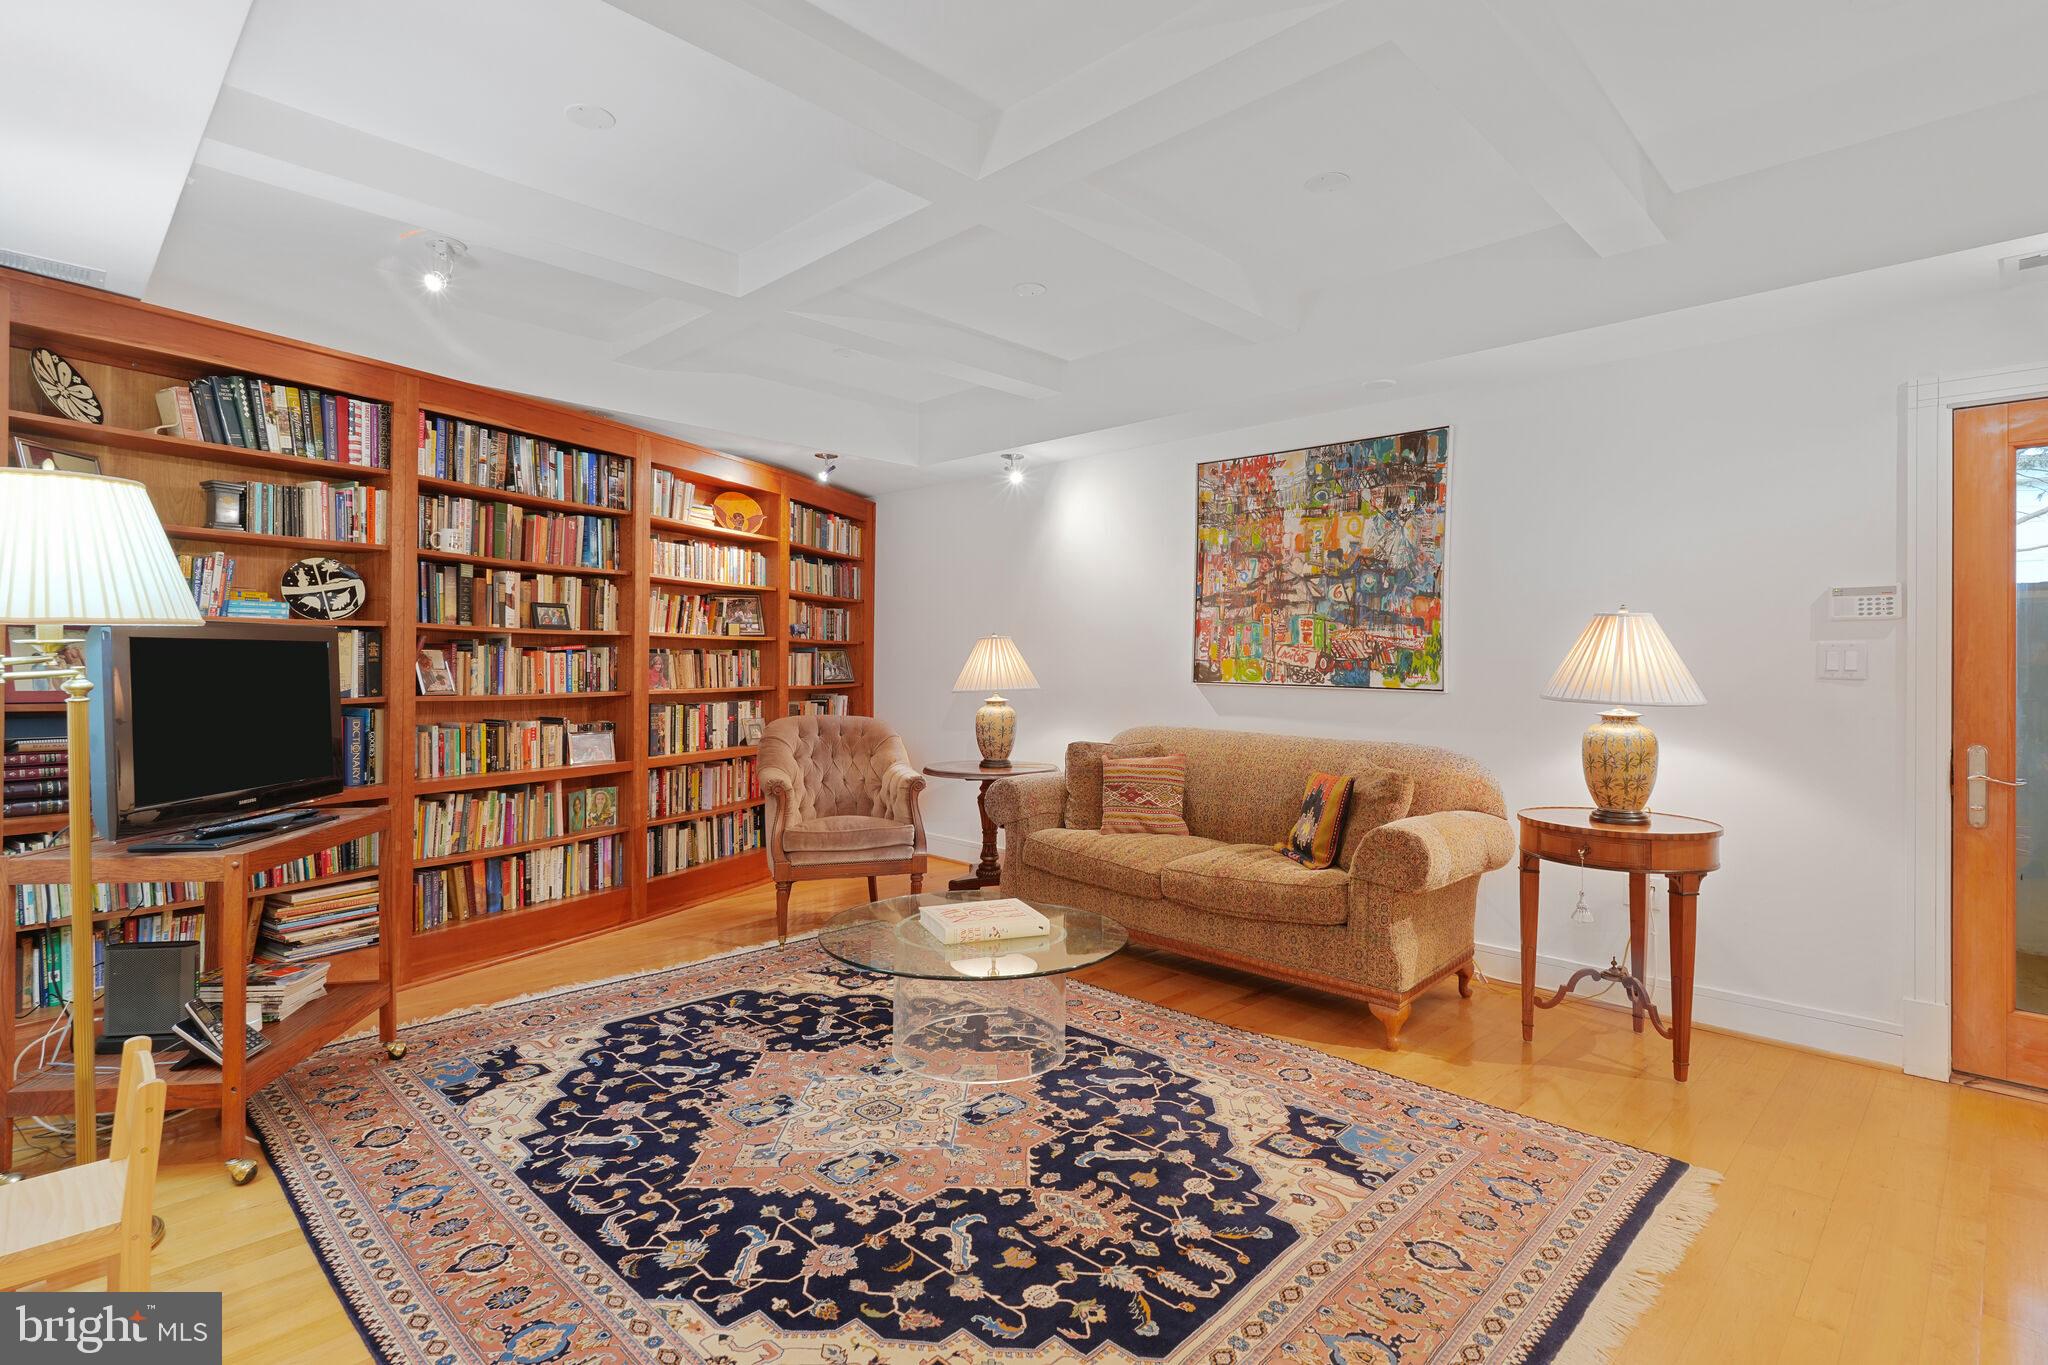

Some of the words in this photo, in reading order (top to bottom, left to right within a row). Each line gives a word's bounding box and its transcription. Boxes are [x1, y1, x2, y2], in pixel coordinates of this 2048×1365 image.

[290, 400, 305, 440] Mayflower
[203, 572, 211, 595] Thailand
[351, 720, 362, 780] DICTIONARY
[238, 798, 257, 806] SAMSUNG
